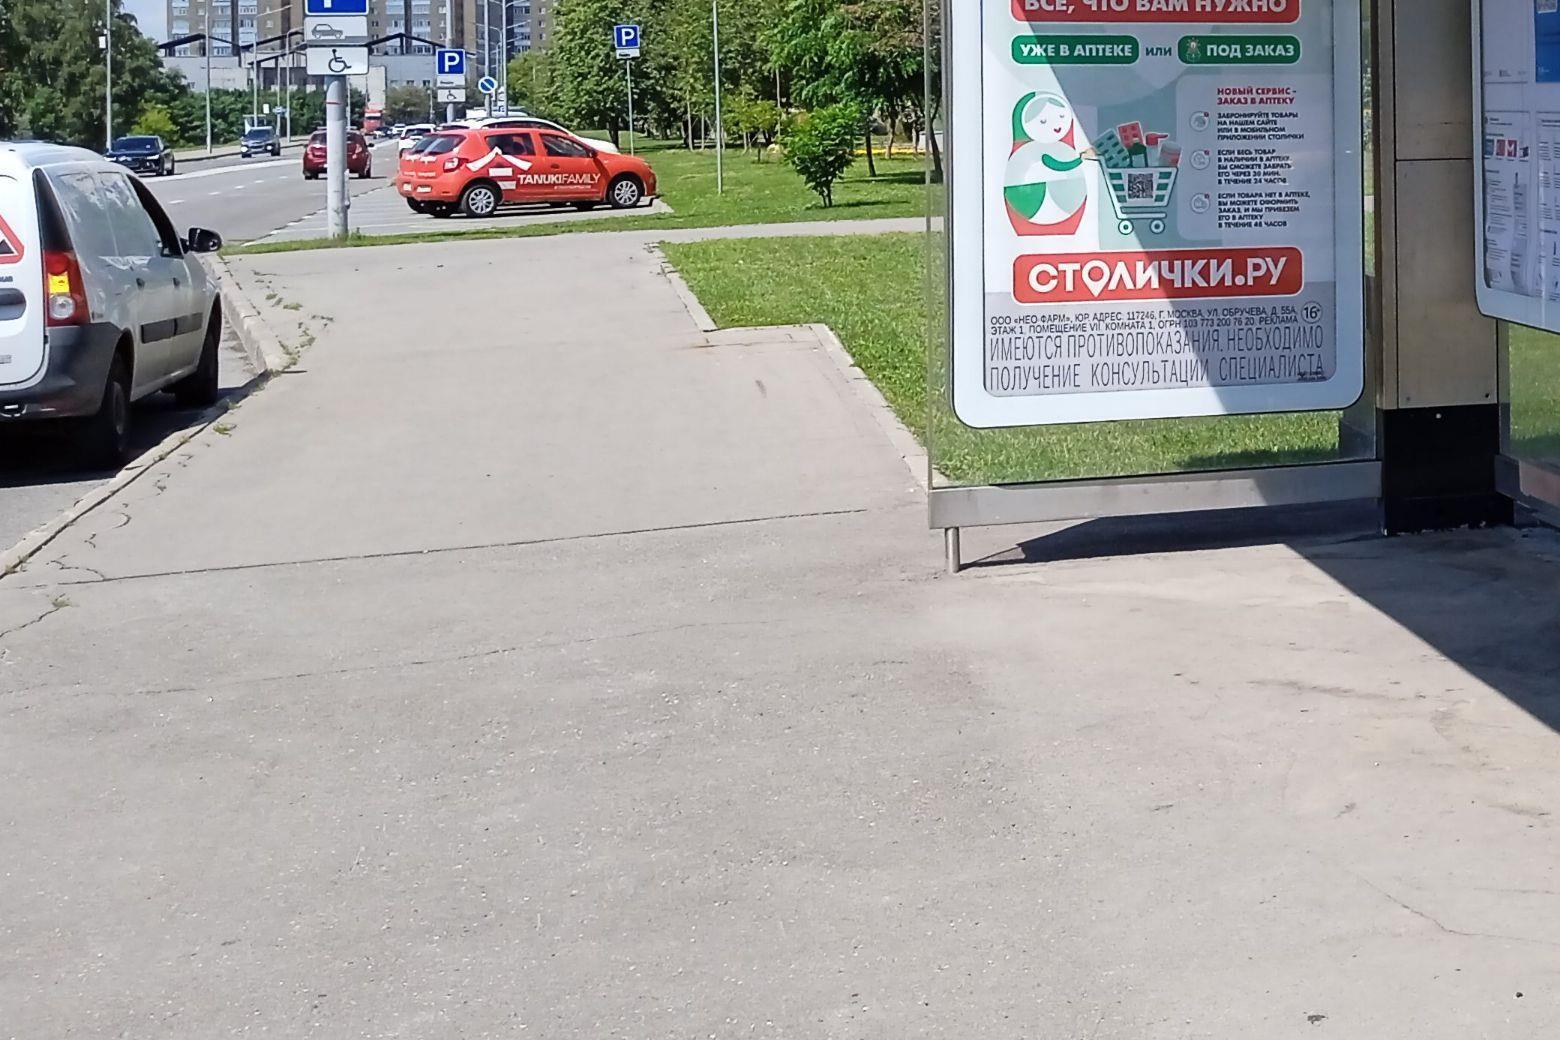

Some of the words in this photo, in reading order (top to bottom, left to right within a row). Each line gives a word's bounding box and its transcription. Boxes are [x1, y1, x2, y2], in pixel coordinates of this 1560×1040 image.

[621, 28, 635, 46] P
[1019, 43, 1055, 57] УЖЕ
[1059, 43, 1070, 57] В
[1073, 43, 1133, 57] АПТЕКЕ
[1206, 44, 1242, 59] ПОД
[1244, 44, 1295, 57] ЗАКАЗ
[444, 52, 460, 72] P
[1217, 86, 1254, 95] НОВЫЙ
[1256, 87, 1291, 95] СЕРВИС
[1217, 97, 1248, 105] ЗАКАЗ
[1250, 97, 1256, 105] В
[1258, 97, 1295, 105] АПТЕКУ
[1217, 111, 1269, 119] ЗАБРОНИРУЙТЕ
[1028, 256, 1288, 298] СТОЛИЧКИ.РУ
[990, 316, 1012, 325] ООО
[990, 326, 1017, 336] ЭТАЖ
[1029, 323, 1087, 334] ПОМЕЩЕНИЕ
[1105, 321, 1146, 331] КОМНАТА
[1158, 320, 1182, 329] ОГРН
[1184, 319, 1198, 328] 103
[1200, 318, 1215, 327] 773
[1216, 317, 1231, 327] 200
[1259, 315, 1299, 325] РЕКЛАМА
[990, 335, 1062, 361] ИМЕЮТСЯ
[1067, 327, 1223, 359] ПРОТИВОПОКАЗАНИЯ.
[1227, 325, 1324, 352] НЕОБХОДИМО
[990, 363, 1081, 391] ПОЛУЧЕНИЕ
[1091, 358, 1209, 387] КОНСУЛЬТАЦИИ
[1218, 353, 1324, 382] СПЕЦИАЛИСТА
